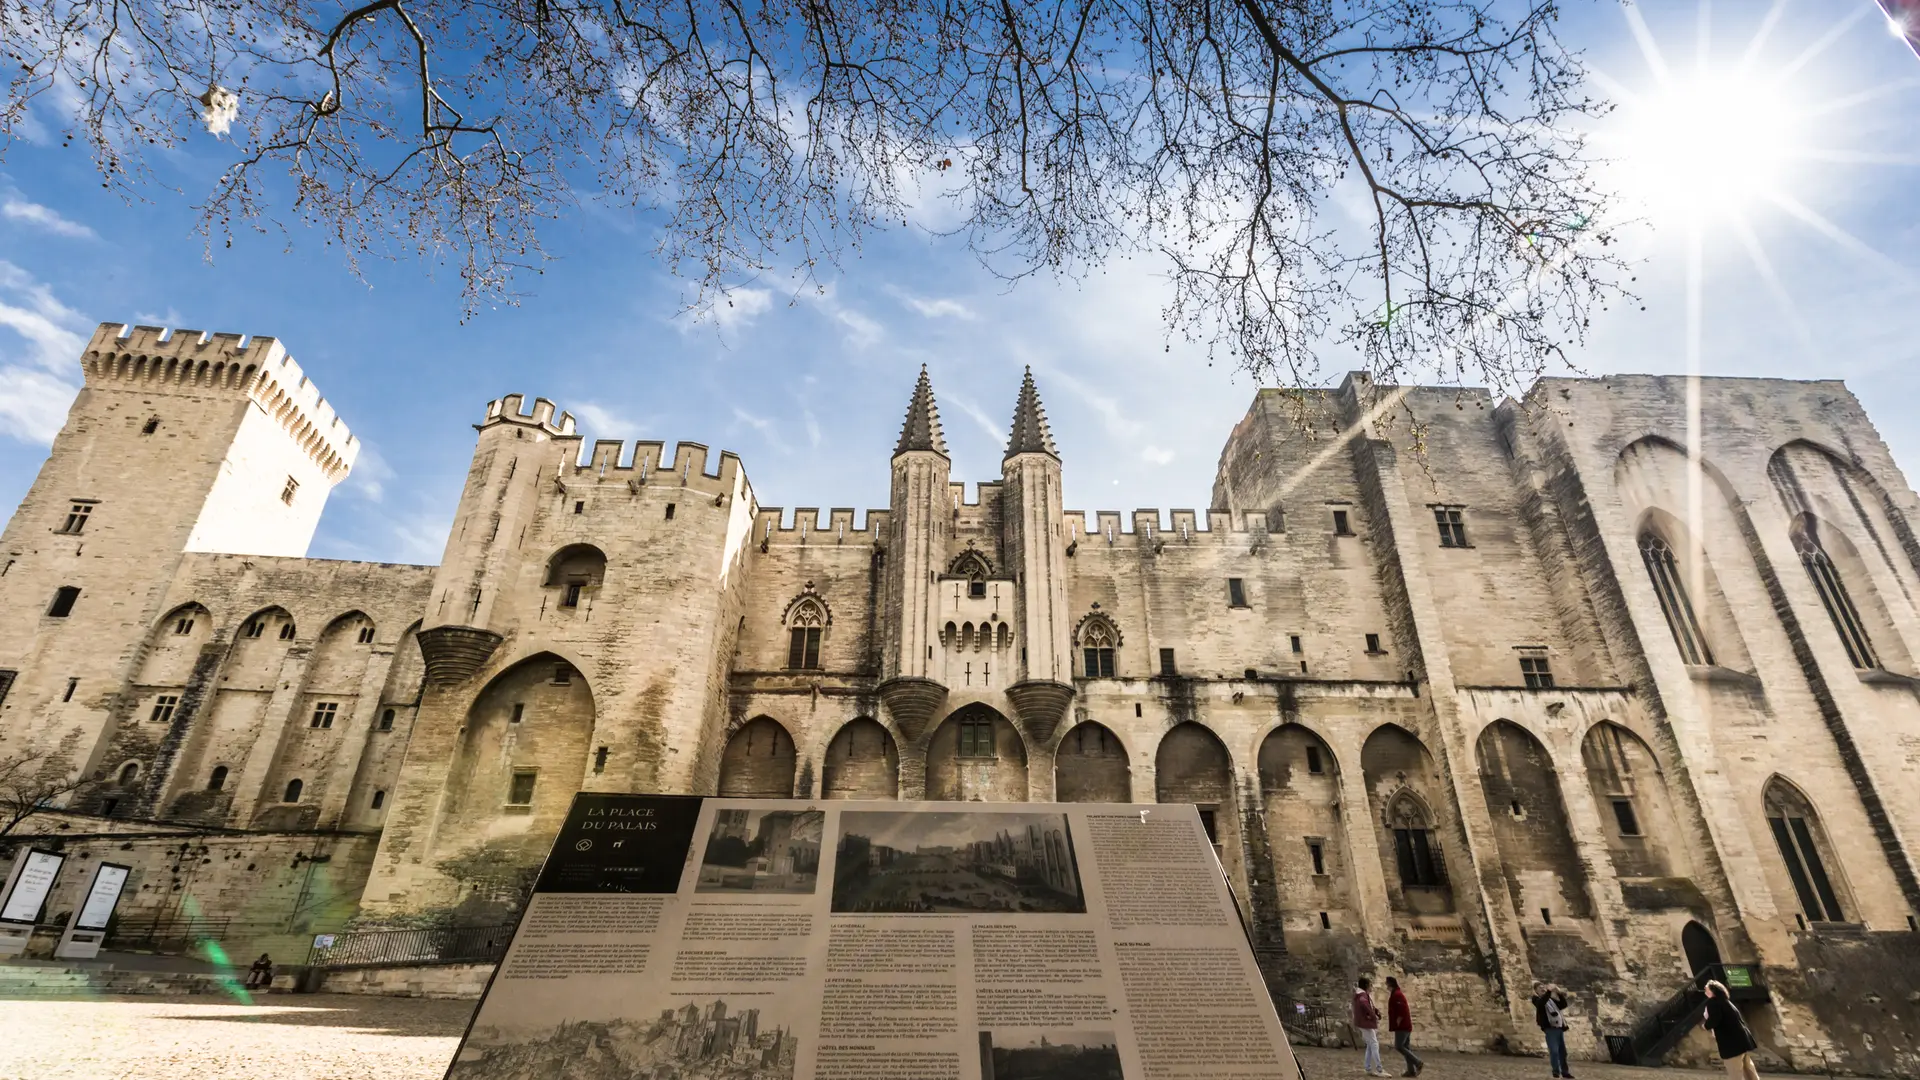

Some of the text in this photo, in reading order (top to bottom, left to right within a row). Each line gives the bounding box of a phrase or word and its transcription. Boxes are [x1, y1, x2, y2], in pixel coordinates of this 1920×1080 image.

[587, 808, 655, 816] LA PLACE
[581, 821, 658, 830] DU PALAIS
